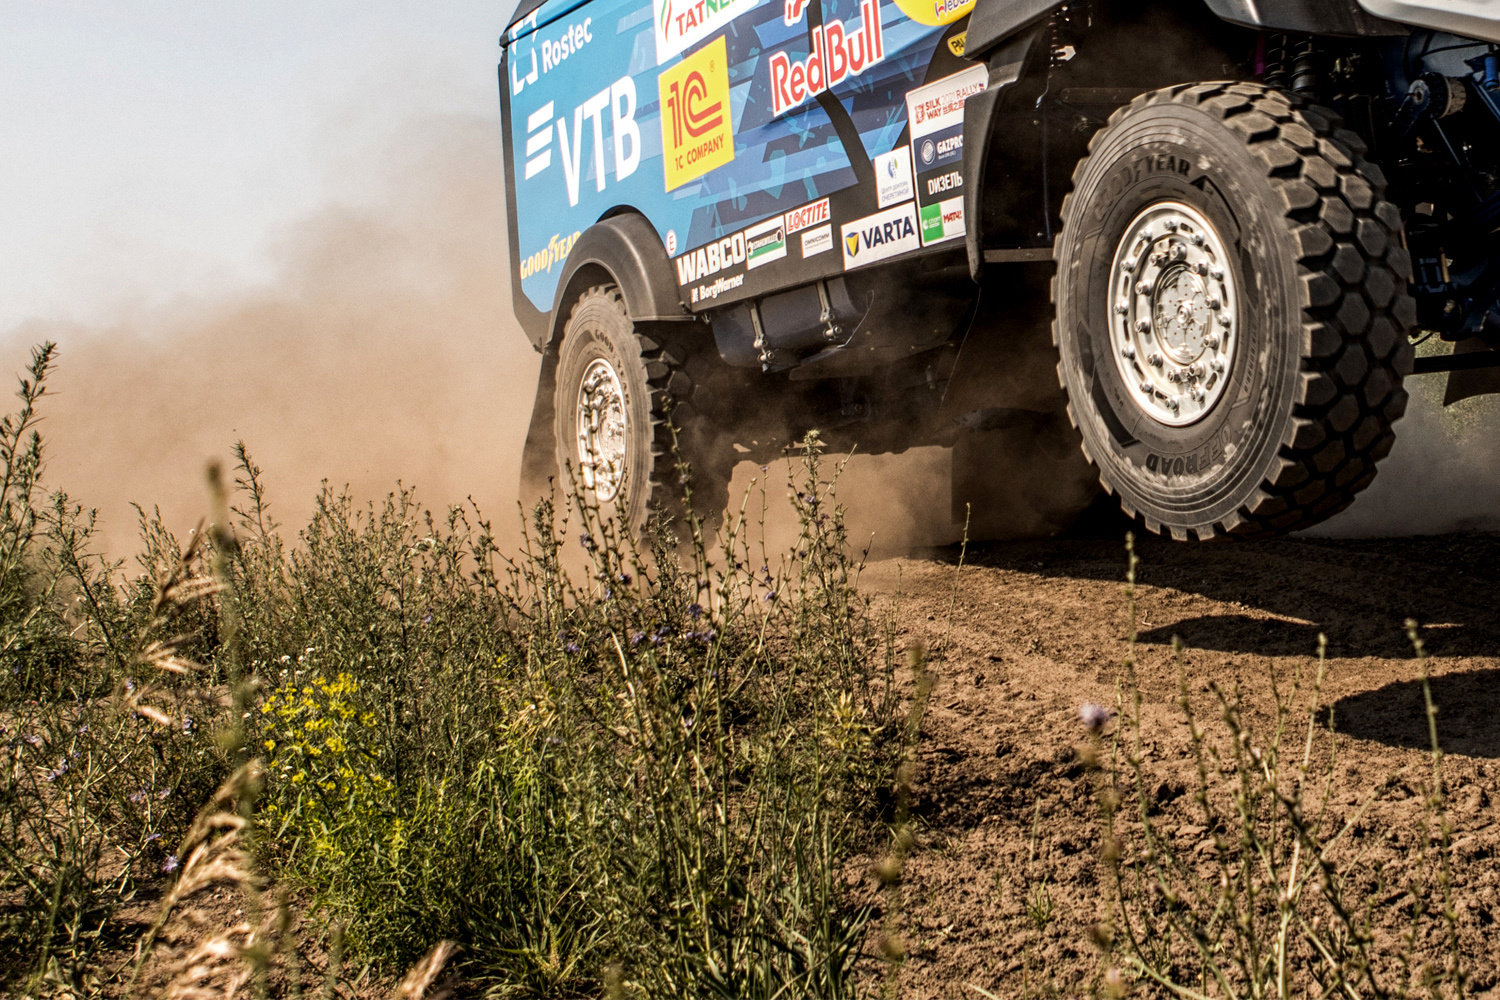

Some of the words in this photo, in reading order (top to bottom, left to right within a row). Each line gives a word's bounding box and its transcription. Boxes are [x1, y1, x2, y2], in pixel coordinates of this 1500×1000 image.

[542, 17, 592, 73] Rostec
[925, 97, 941, 111] SILK
[955, 83, 978, 99] RALLY
[926, 106, 942, 120] WAY
[556, 75, 640, 207] VTB
[687, 133, 724, 165] COMPANY
[787, 201, 828, 232] LOCTITE
[862, 216, 915, 249] VARTA
[676, 232, 746, 286] WABCO
[700, 274, 744, 300] BorgWarner
